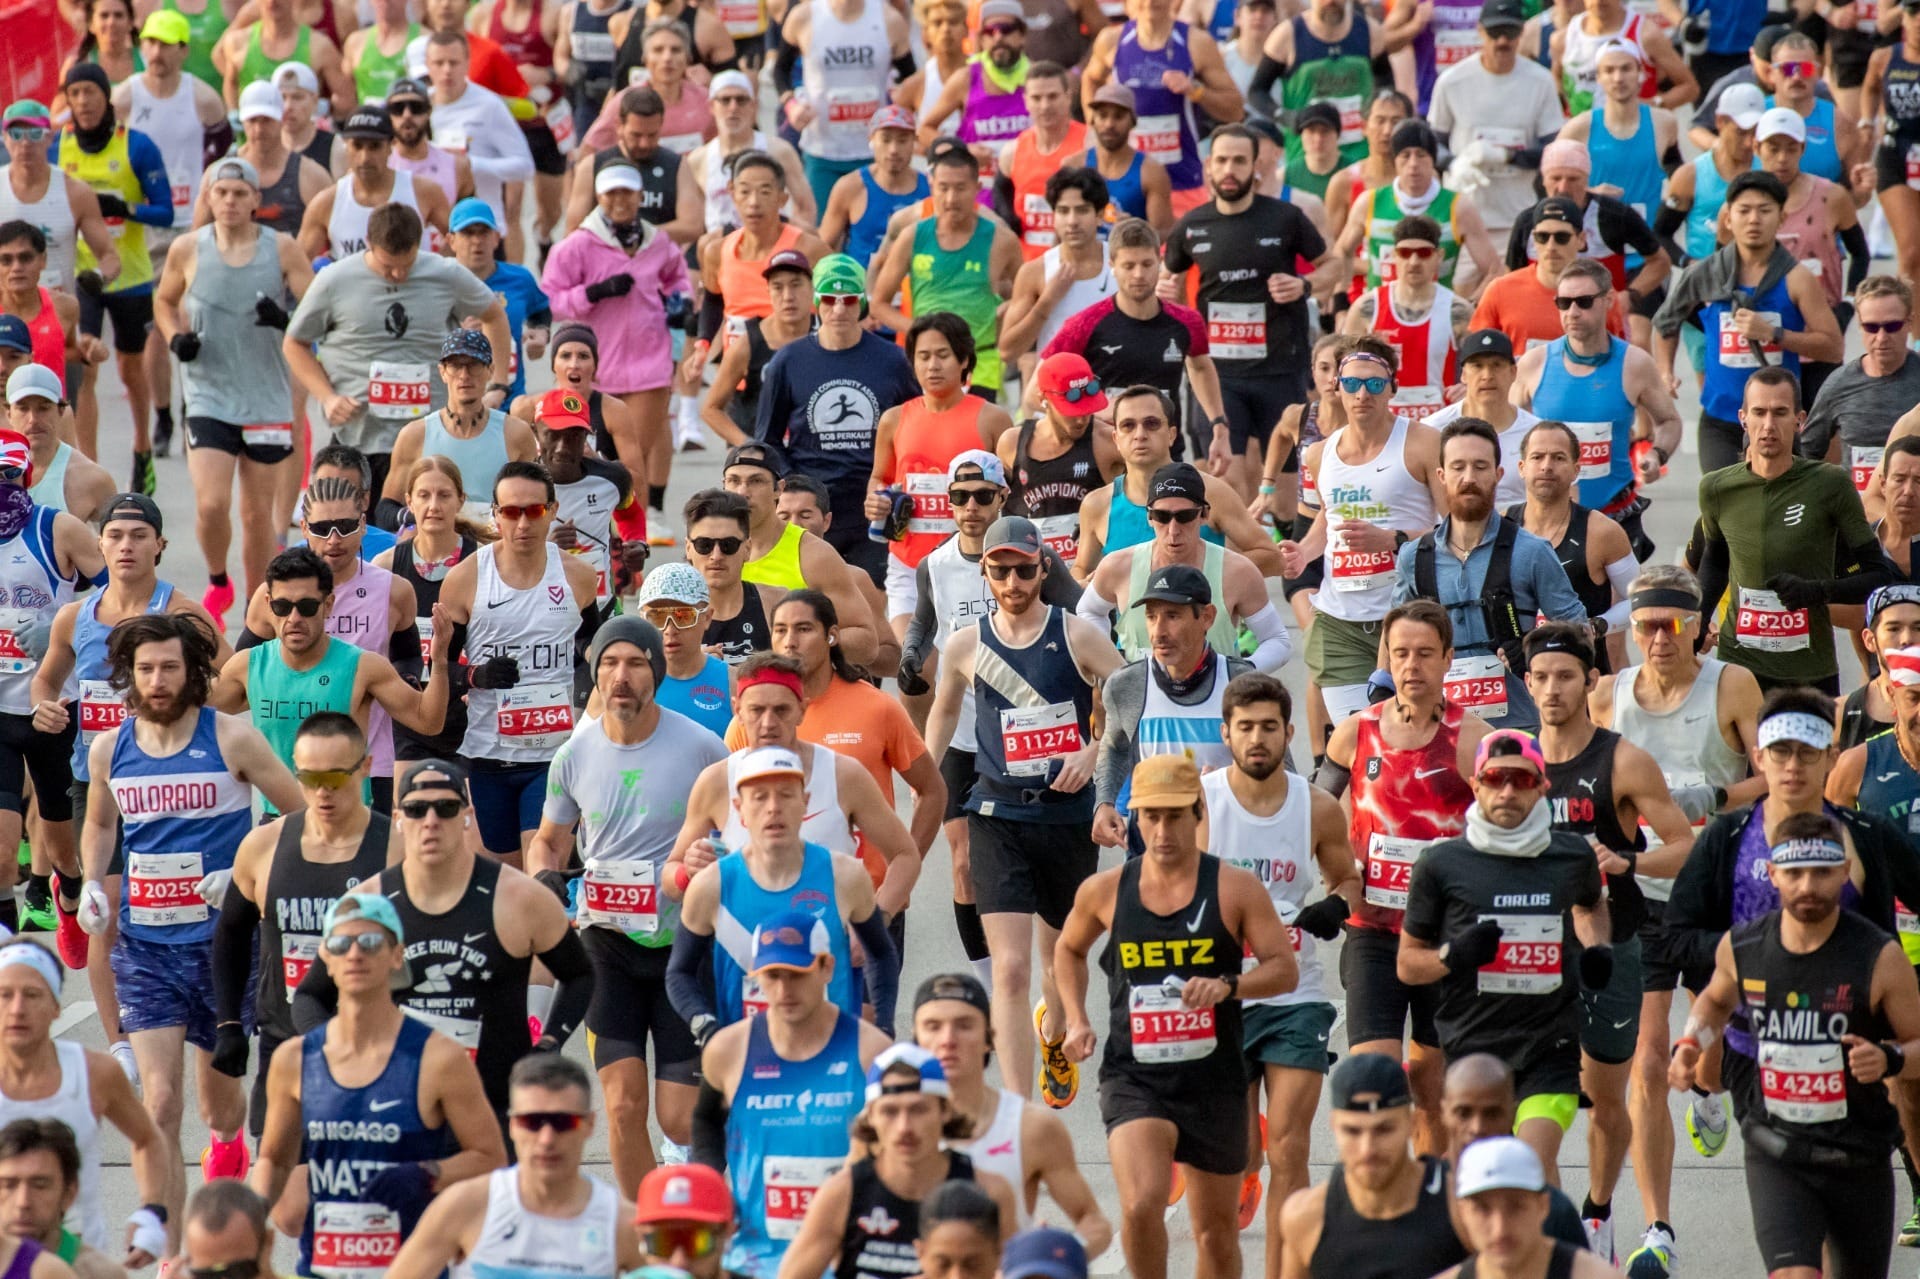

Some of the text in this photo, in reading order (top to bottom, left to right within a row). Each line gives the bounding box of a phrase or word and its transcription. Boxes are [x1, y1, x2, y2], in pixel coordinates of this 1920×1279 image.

[824, 46, 875, 66] NBR
[974, 114, 1031, 136] MÉXIC
[1211, 321, 1265, 339] B 22978
[371, 383, 429, 400] B 1219
[1331, 485, 1372, 504] Trak
[1344, 552, 1390, 568] 20265
[12, 585, 51, 608] Rico
[1740, 611, 1806, 629] B 8203
[1452, 681, 1504, 699] 21259
[83, 708, 93, 722] B
[501, 709, 570, 728] B 7364
[1006, 737, 1017, 751] B
[1023, 728, 1077, 749] 11274
[117, 782, 217, 814] COLORADO
[1370, 863, 1382, 880] B
[129, 881, 140, 896] B
[586, 886, 652, 905] B 2297
[1493, 893, 1551, 907] CARLOS
[429, 939, 459, 955] RUN
[460, 944, 488, 968] TWO
[1119, 938, 1215, 969] BETZ
[1504, 944, 1559, 965] 4259
[286, 963, 297, 978] B
[453, 997, 475, 1008] CITY
[1133, 1012, 1212, 1033] B 11226
[1754, 1007, 1849, 1042] CAMILO
[1764, 1073, 1843, 1095] B 4246
[747, 1091, 854, 1110] FLEET FEET
[309, 1120, 400, 1143] CHICAGO
[310, 1159, 400, 1196] MAT
[768, 1189, 780, 1209] B
[316, 1235, 396, 1258] C 16002
